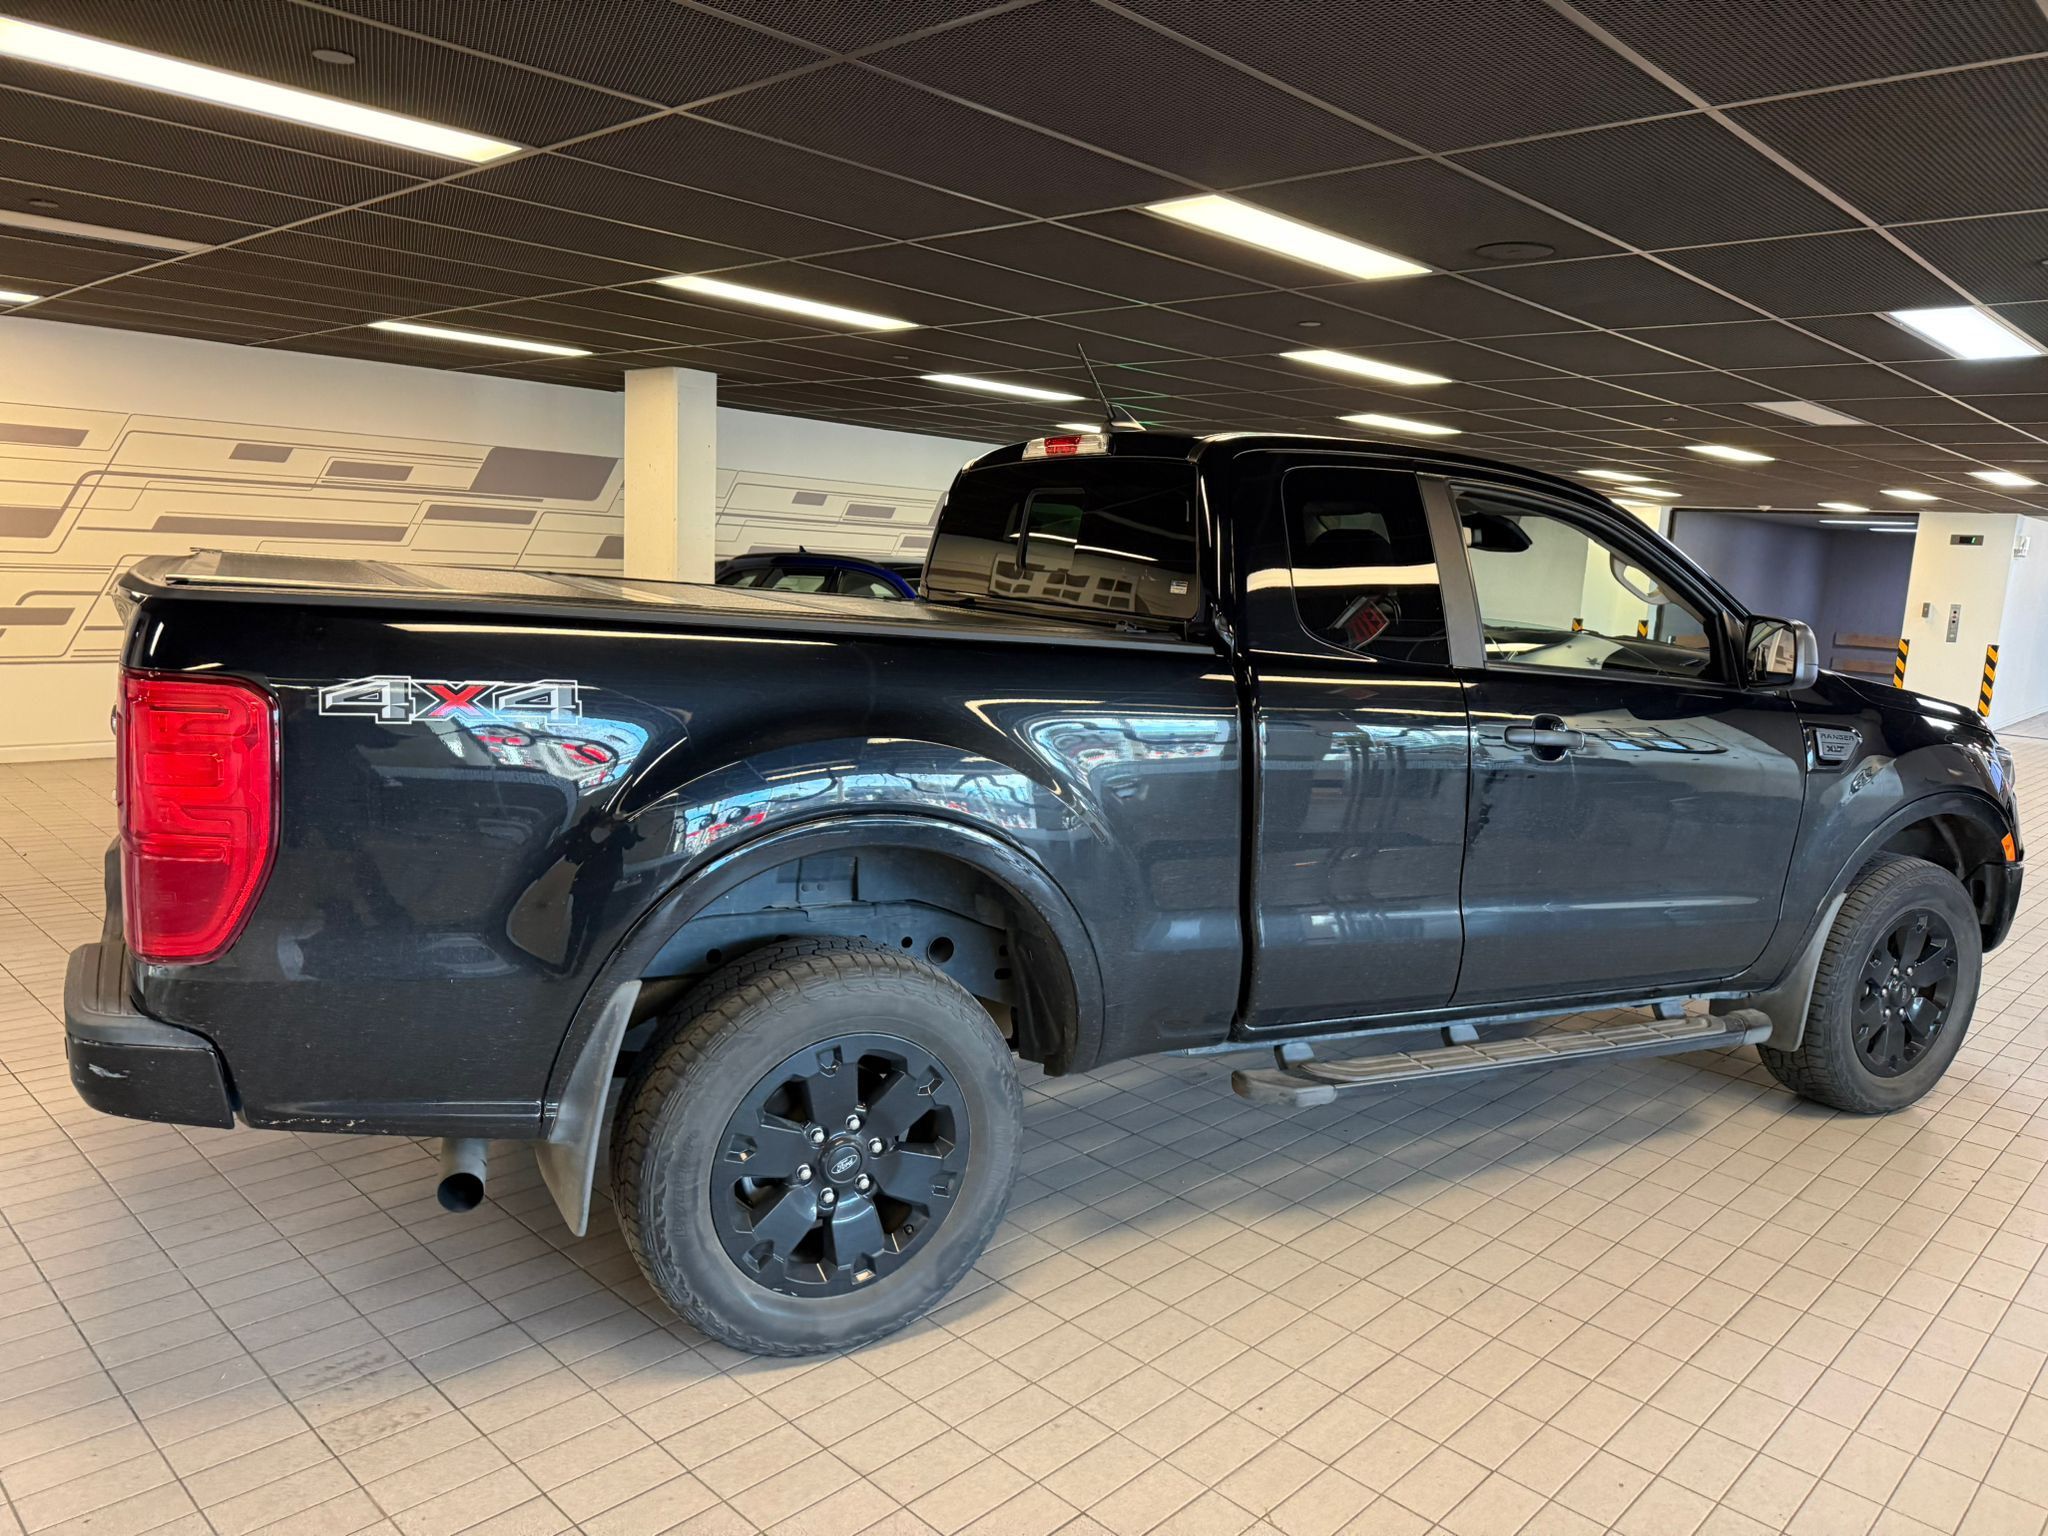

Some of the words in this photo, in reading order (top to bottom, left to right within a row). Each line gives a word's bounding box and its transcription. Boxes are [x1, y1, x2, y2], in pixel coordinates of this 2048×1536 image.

[1820, 732, 1855, 741] RANGER
[1826, 745, 1845, 753] XLT
[834, 1156, 855, 1173] Ford
